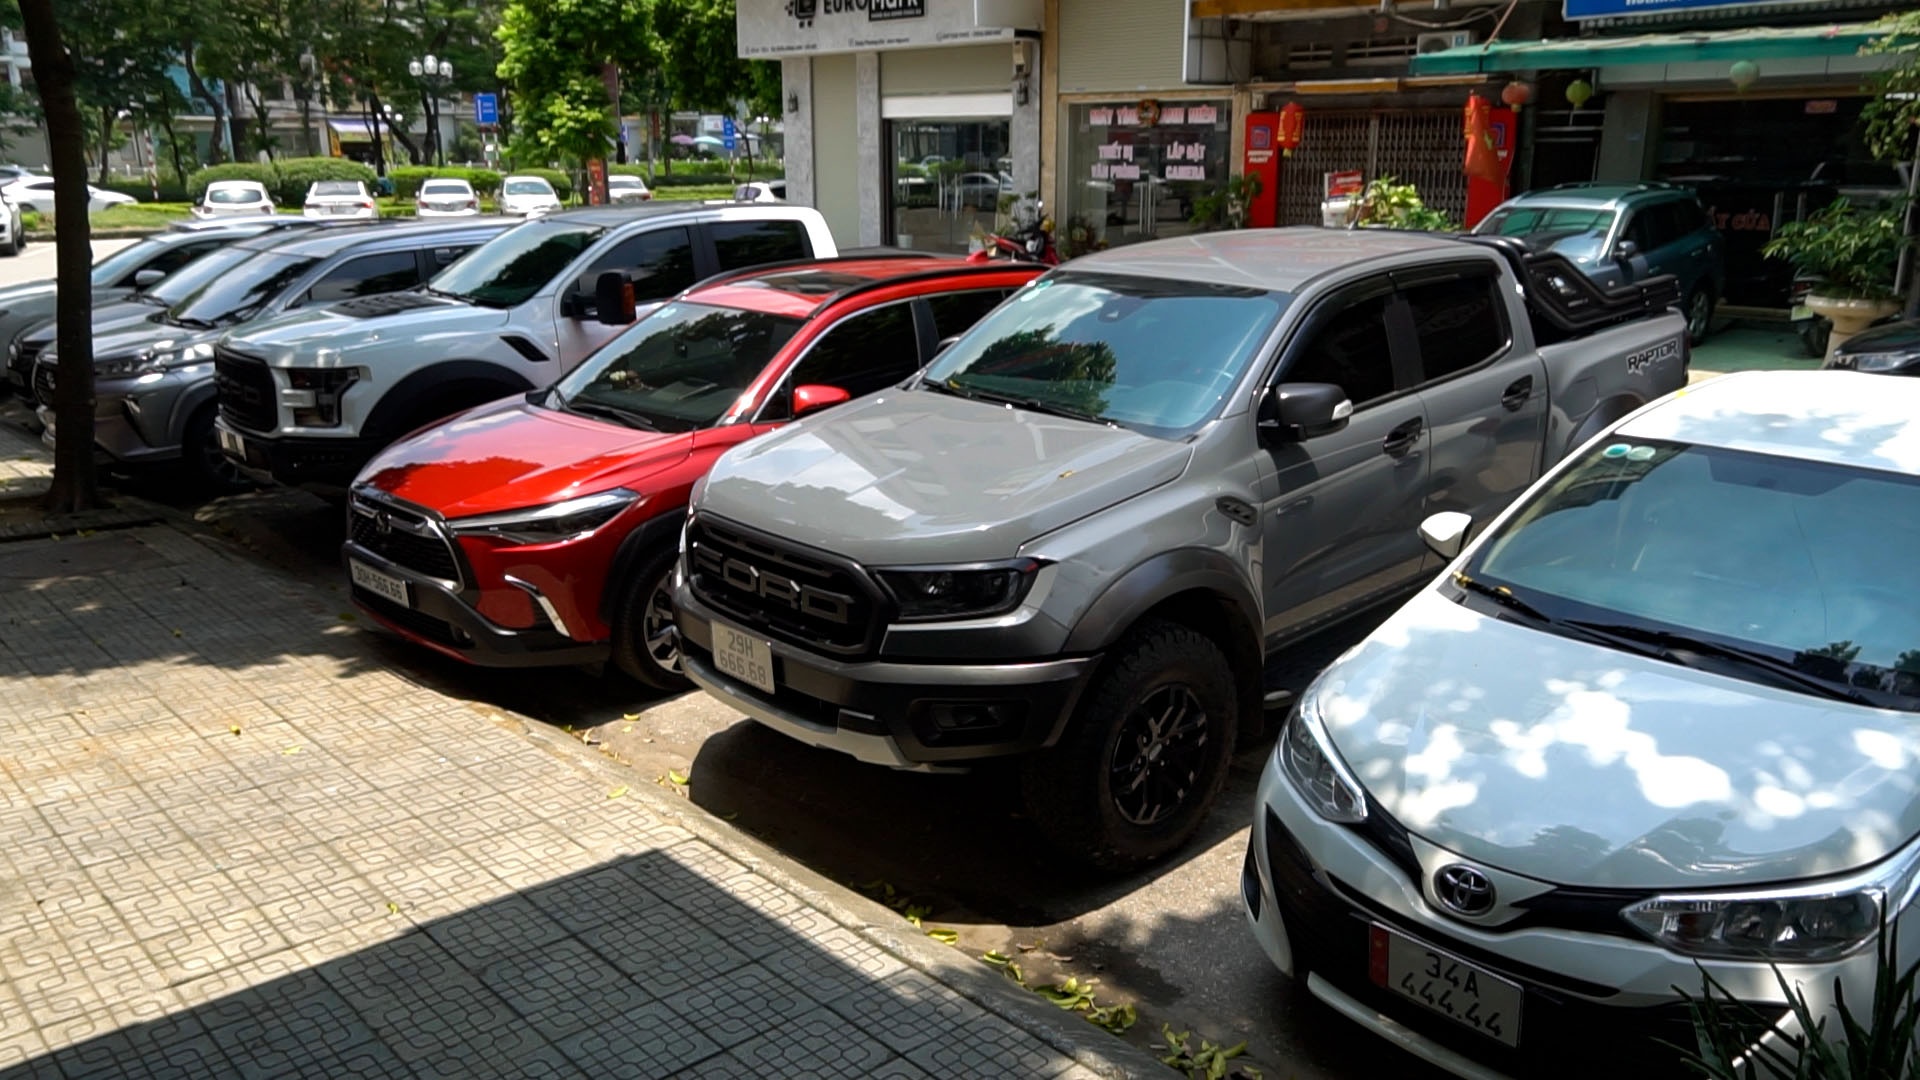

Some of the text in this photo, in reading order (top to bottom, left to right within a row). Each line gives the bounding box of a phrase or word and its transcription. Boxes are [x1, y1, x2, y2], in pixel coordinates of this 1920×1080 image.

[1166, 166, 1205, 180] CAMERA
[1626, 338, 1679, 375] RAPTOR
[694, 542, 855, 624] FORD
[728, 630, 754, 659] 29H
[720, 649, 766, 685] 666.68
[1424, 952, 1479, 998] 34A
[1401, 972, 1502, 1037] 444.44
